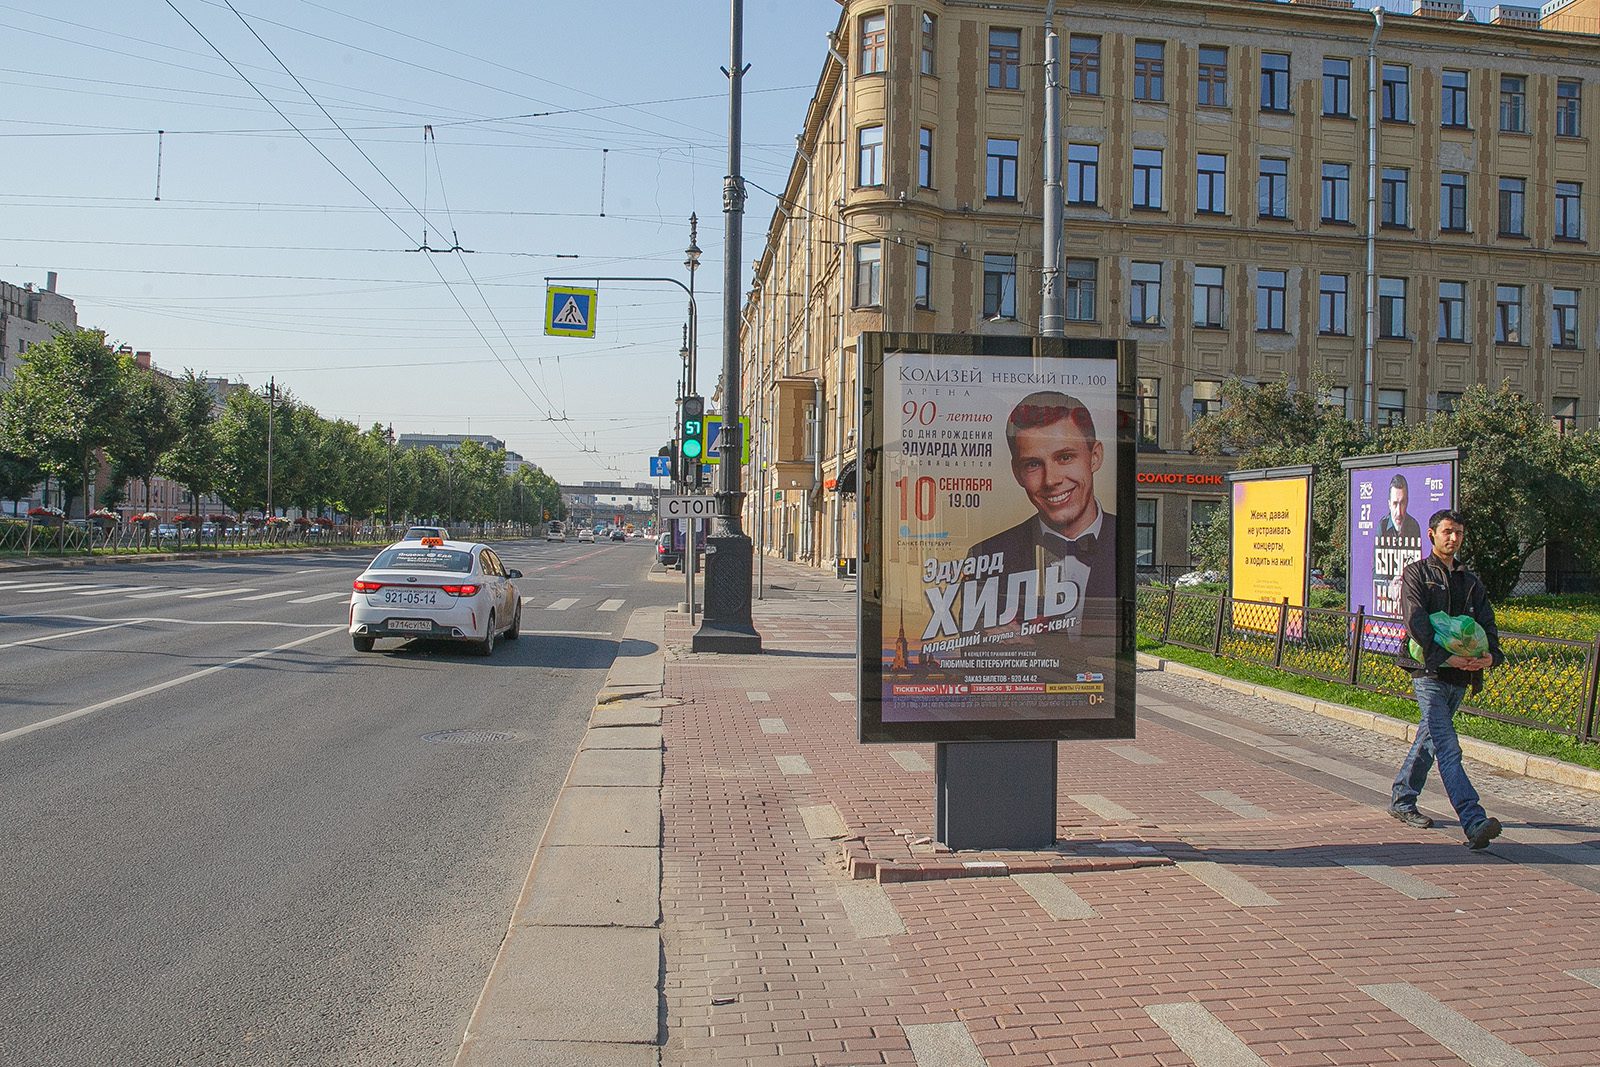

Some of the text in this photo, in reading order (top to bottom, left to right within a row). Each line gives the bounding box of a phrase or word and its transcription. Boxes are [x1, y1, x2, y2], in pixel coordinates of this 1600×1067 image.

[899, 366, 983, 384] КОЛИЗЕЙ
[992, 371, 1107, 386] НЕВСКИЙ ПР., 100
[906, 388, 971, 397] АРЕНА
[685, 421, 701, 435] 57
[902, 429, 993, 440] СО ДНЯ РОЖДЕНИЯ
[902, 441, 992, 458] ЭДУАРДА ХИЛЯ
[939, 477, 993, 491] СЕНТЯБРЯ
[895, 476, 937, 521] 10
[948, 493, 980, 508] 19.00
[669, 500, 716, 514] СТОП
[1360, 503, 1372, 521] 27
[1250, 509, 1290, 521] Женя, давай
[1247, 526, 1291, 538] не устраивать
[1253, 543, 1285, 552] концерты,
[923, 552, 1005, 585] Эдуард
[1245, 556, 1293, 567] а ходить на них!
[385, 592, 436, 605] 921-05-14
[922, 565, 1080, 640] ХИЛЬ
[922, 631, 981, 654] младший
[983, 636, 987, 644] и
[988, 632, 1014, 644] группа
[940, 659, 1060, 669] ЛЮБИМЫЕ ПЕТЕРБУРГСКИЕ АРТИСТЫ
[964, 675, 982, 683] ЗАКАЗ
[982, 675, 1008, 683] БИЛЕТОВ
[1088, 693, 1105, 705] 0+
